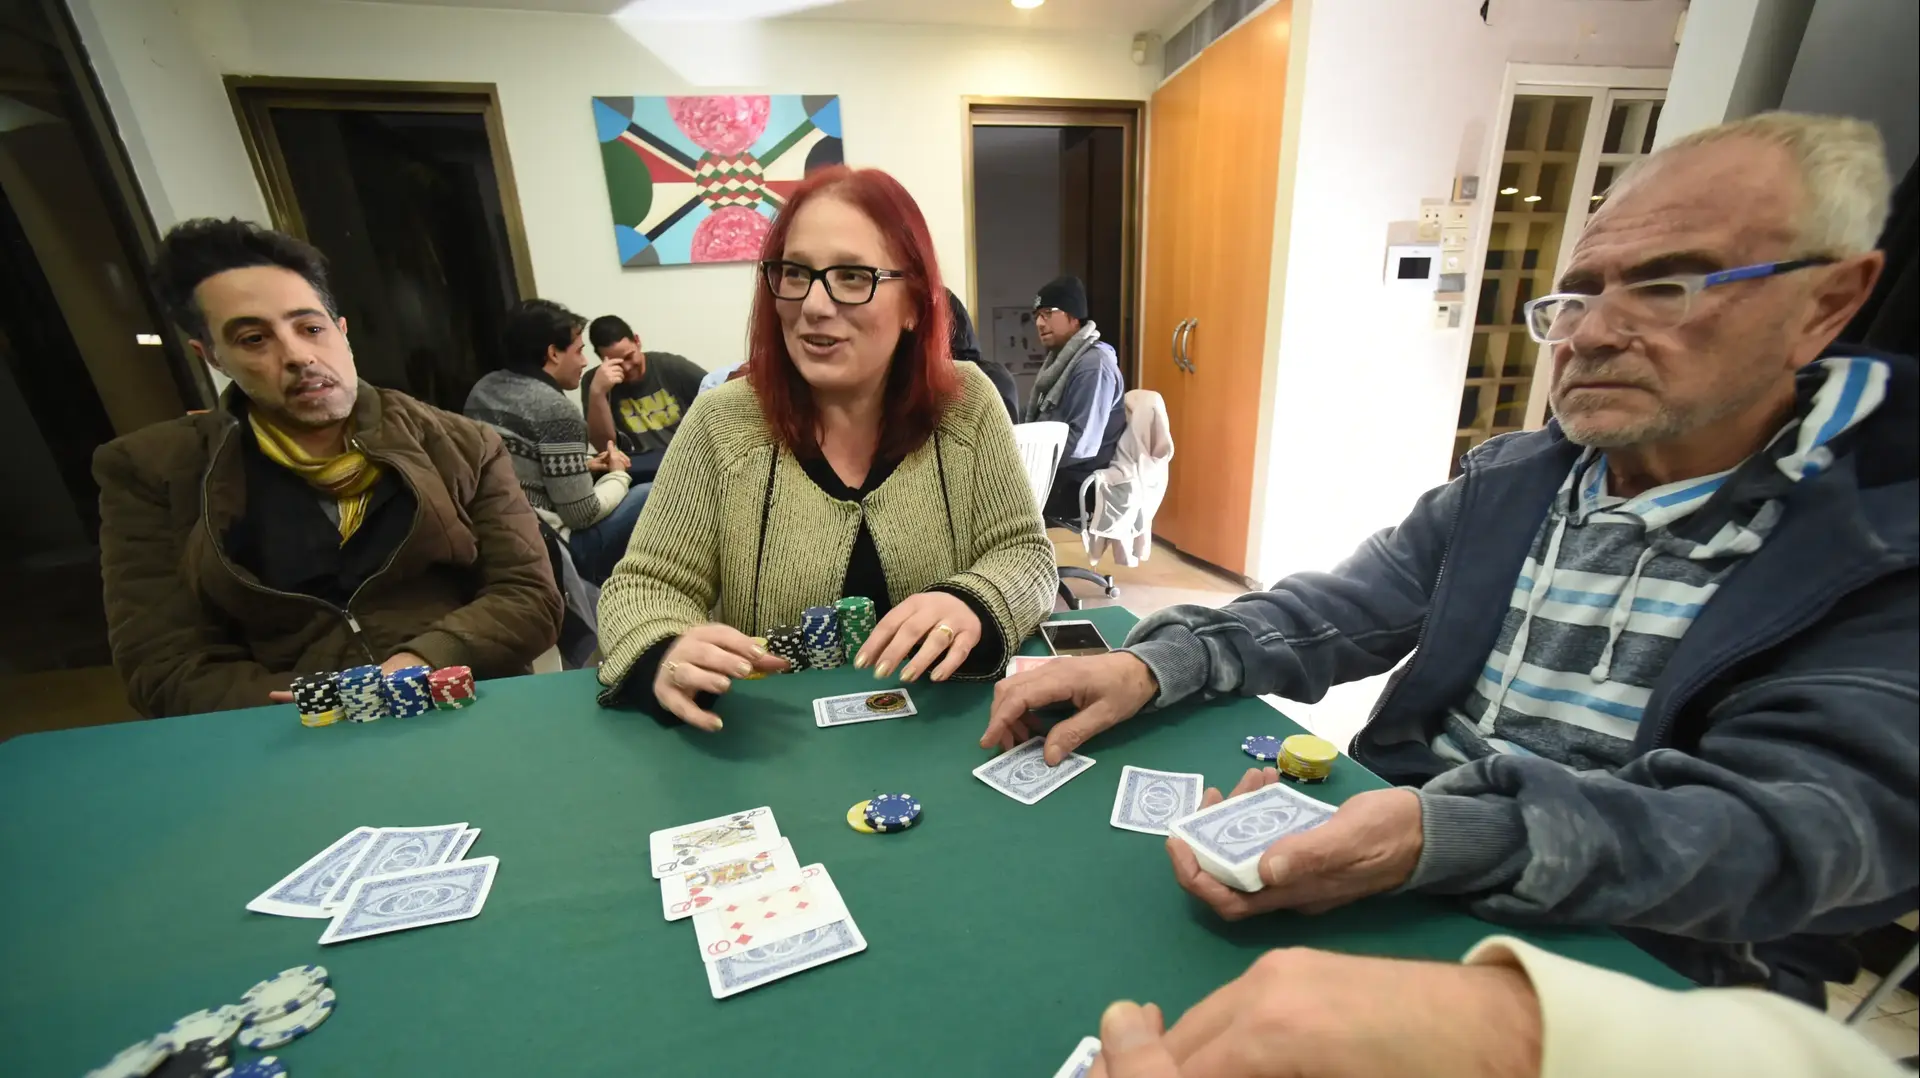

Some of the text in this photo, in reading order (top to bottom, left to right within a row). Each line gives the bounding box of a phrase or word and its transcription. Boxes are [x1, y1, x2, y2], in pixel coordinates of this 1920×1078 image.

[747, 809, 766, 819] Q
[657, 858, 680, 873] Q
[669, 898, 693, 914] Q
[707, 940, 731, 955] 6
